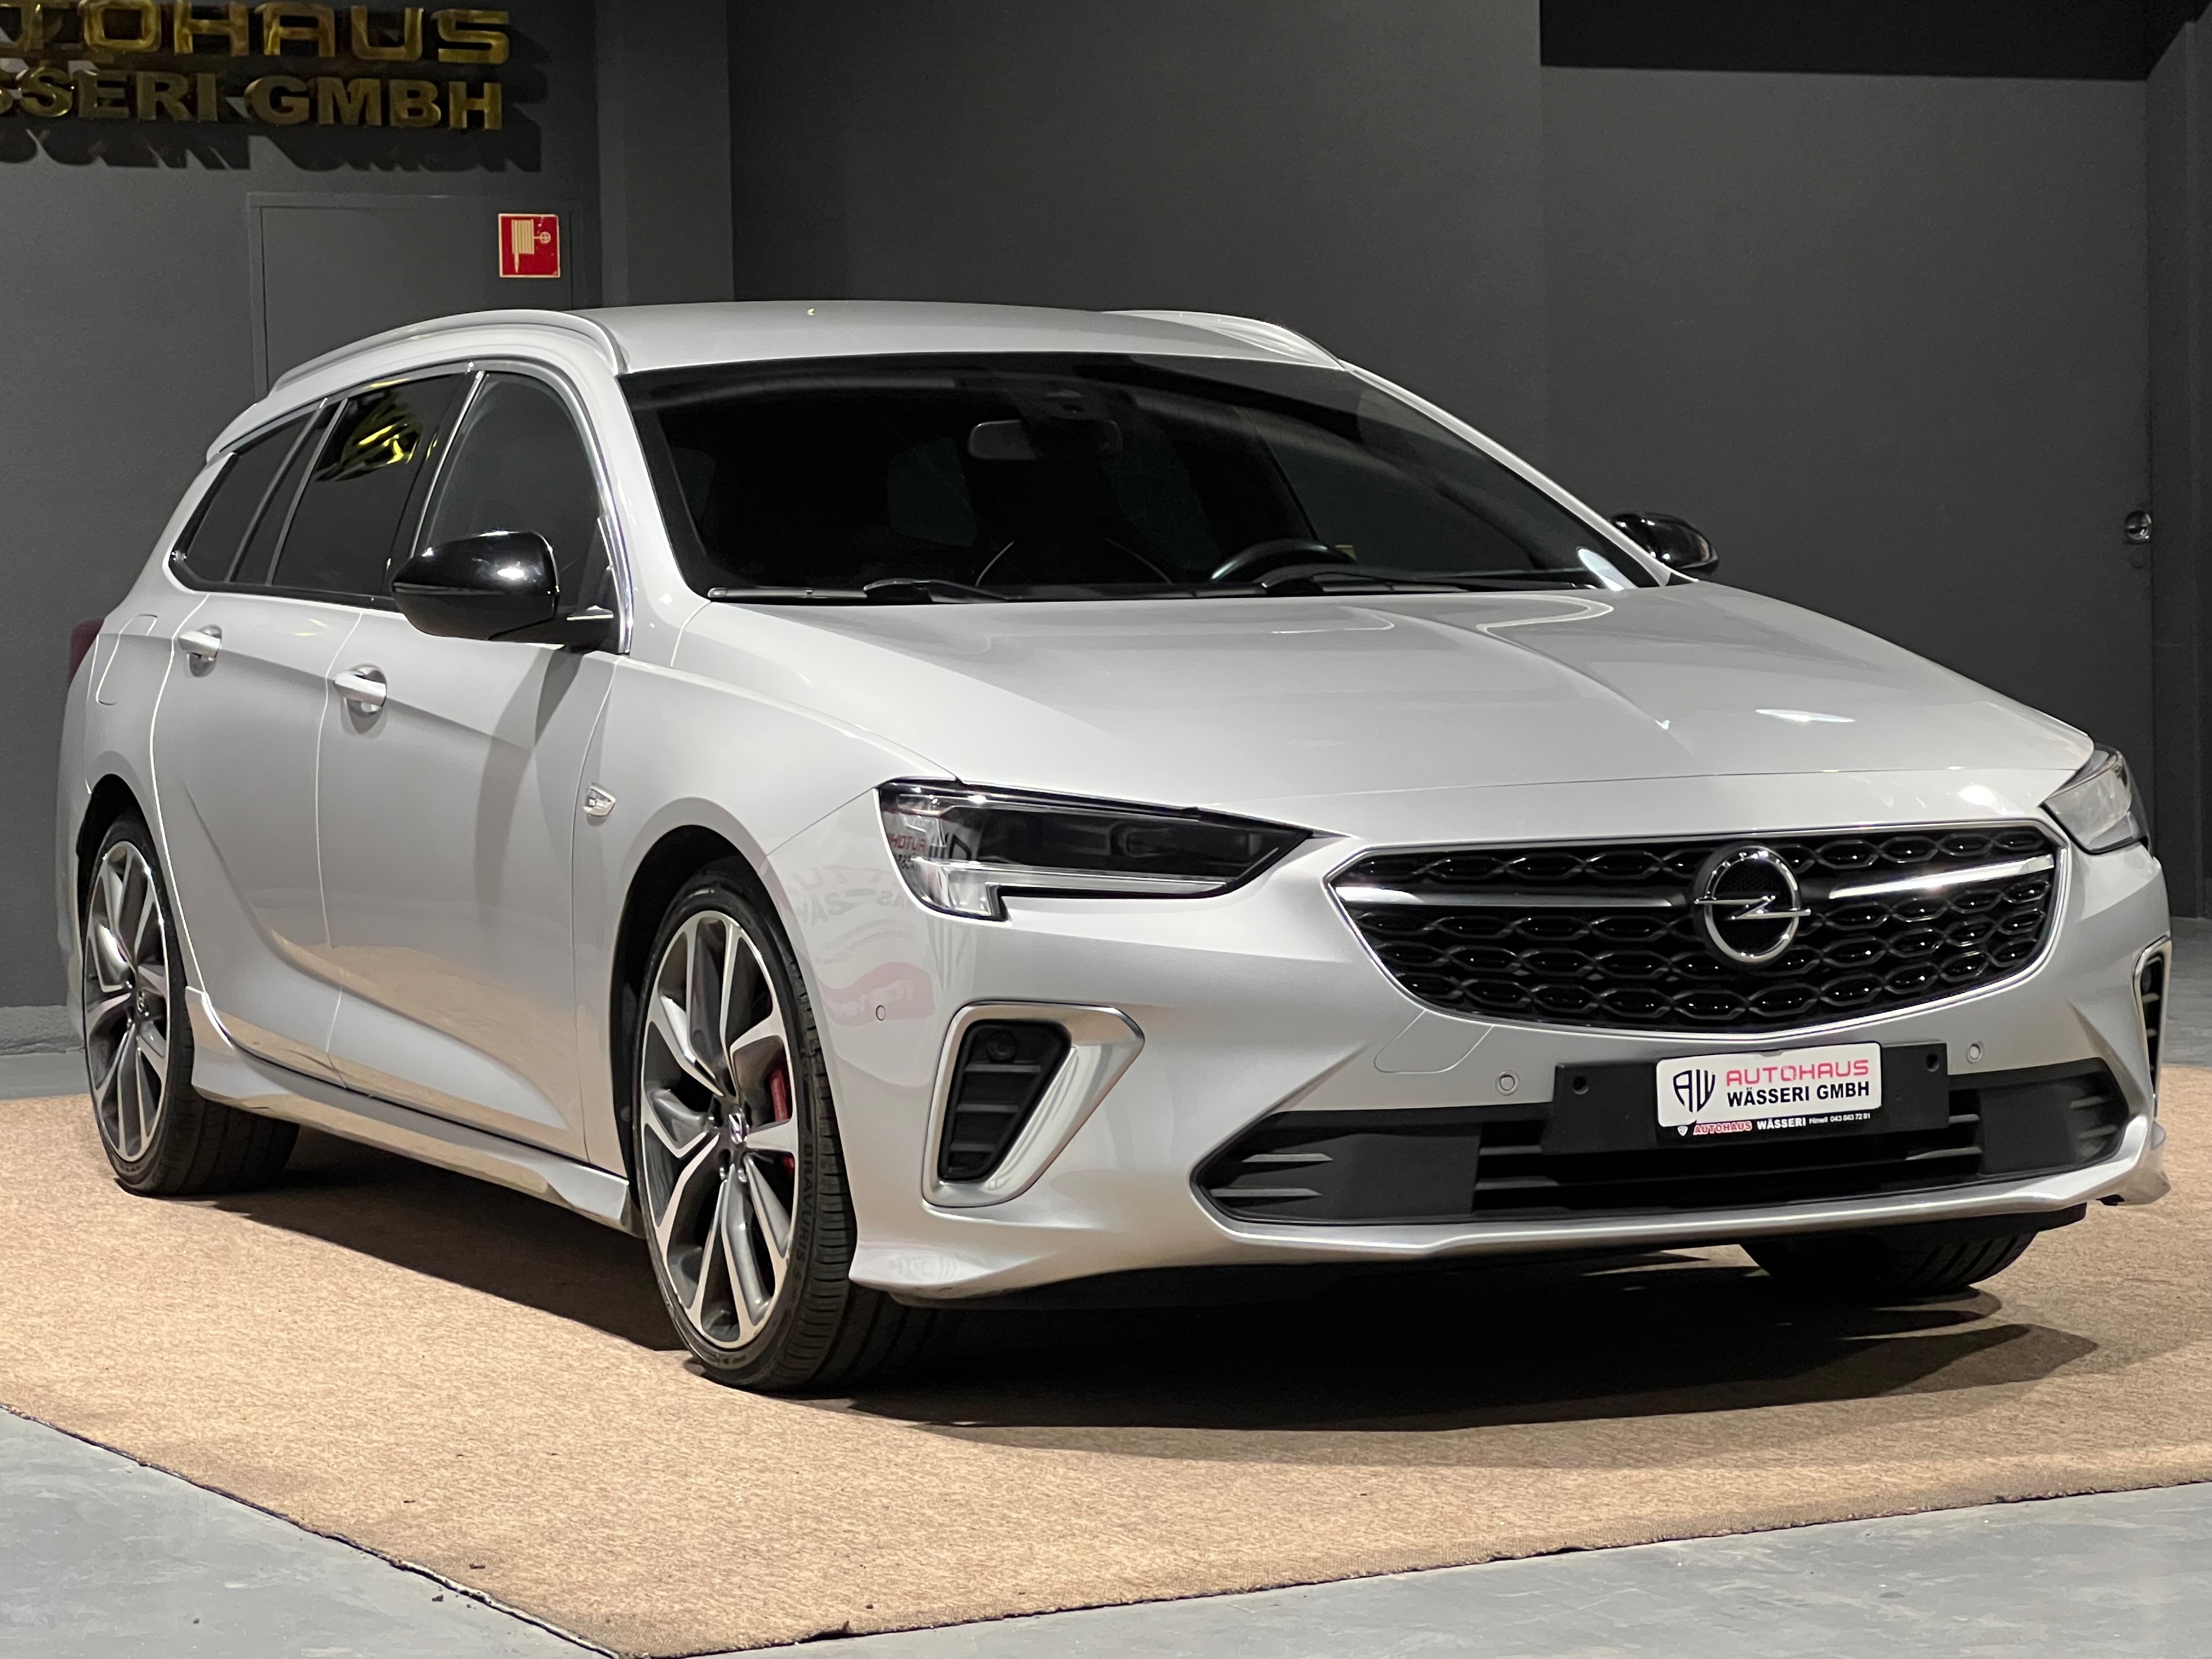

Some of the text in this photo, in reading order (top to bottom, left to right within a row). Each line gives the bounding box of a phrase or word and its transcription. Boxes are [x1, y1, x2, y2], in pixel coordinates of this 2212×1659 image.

[0, 65, 503, 130] SERI GMBH
[1726, 1059, 1869, 1086] AUTOHAUS
[1727, 1081, 1869, 1107] WÄSSERI GMBH
[1693, 1121, 1752, 1135] AUTOHAUS
[796, 1143, 814, 1263] BRAVURIS
